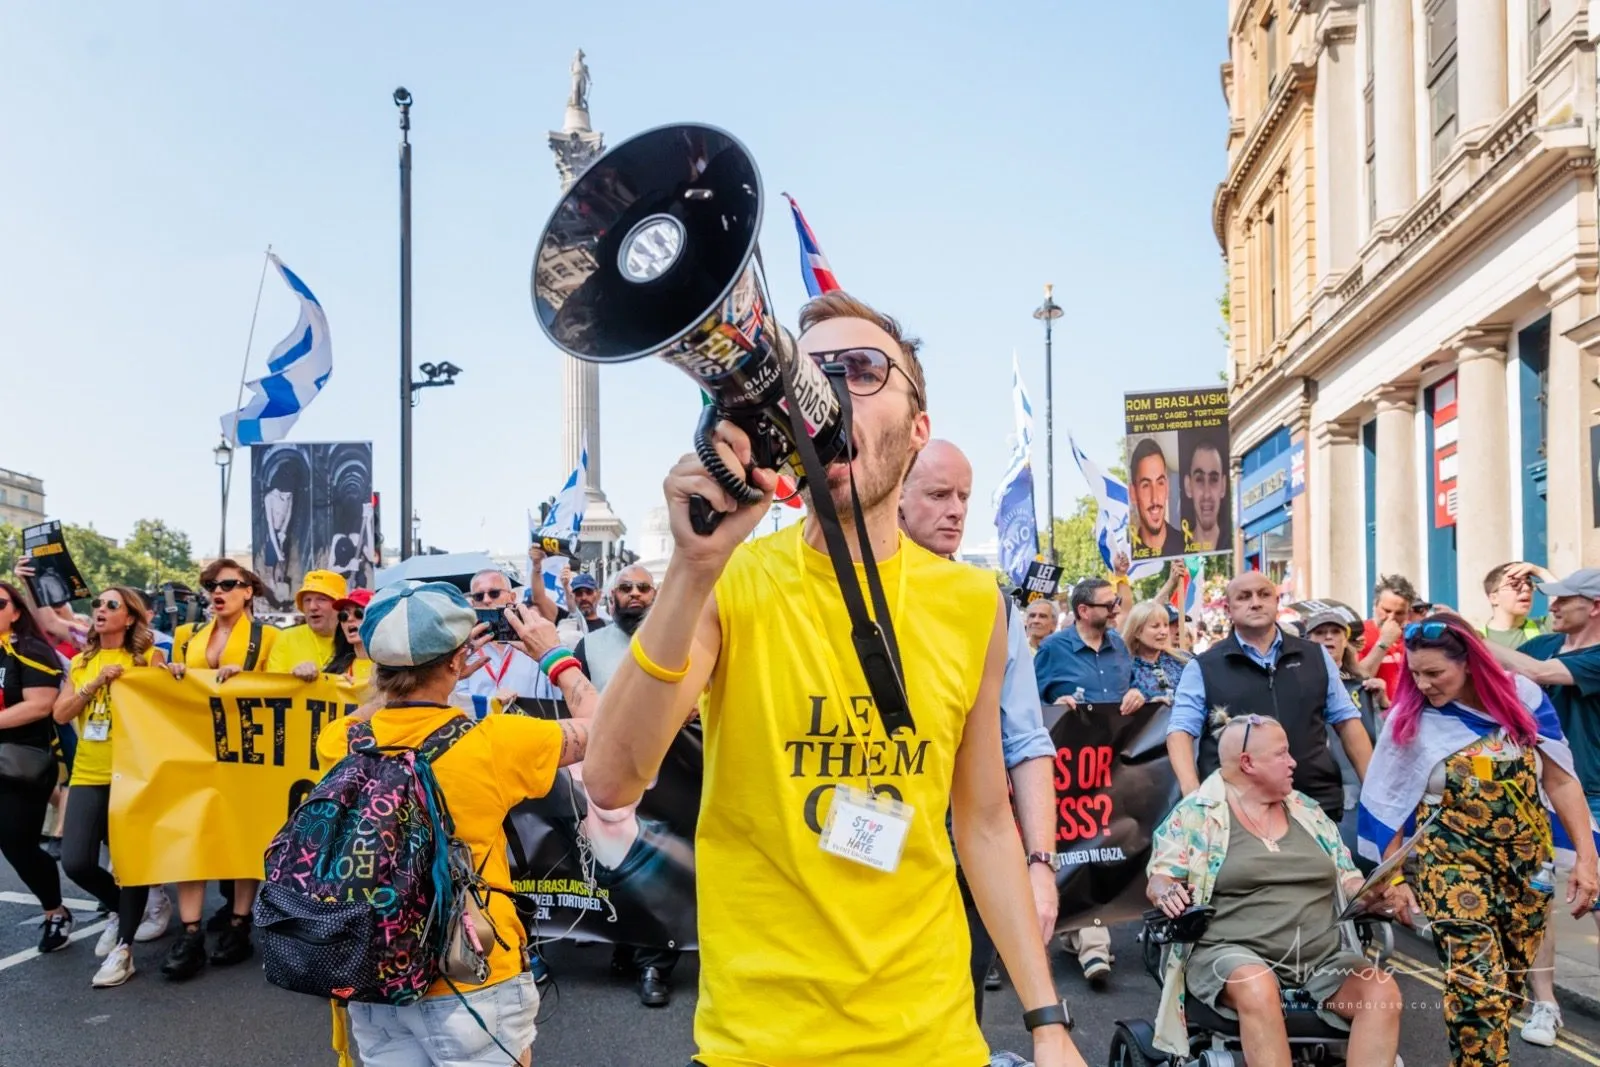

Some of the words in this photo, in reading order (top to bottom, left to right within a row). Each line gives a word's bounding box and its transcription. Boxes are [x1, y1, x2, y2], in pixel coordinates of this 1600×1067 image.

[733, 364, 782, 402] member
[743, 366, 772, 391] 7/10
[794, 373, 828, 426] HMS
[1126, 398, 1151, 411] ROM
[1154, 393, 1229, 409] BRASLAVSKI
[1125, 413, 1158, 422] STARVED
[1164, 410, 1188, 420] CAGED
[1194, 408, 1230, 417] TORTURED
[1147, 422, 1165, 431] YOUR
[1166, 420, 1193, 430] HEROES
[1203, 419, 1222, 427] GAZA
[1036, 564, 1056, 580] LET
[1026, 576, 1056, 593] THEM
[209, 696, 292, 766] LET
[785, 740, 931, 778] THEM
[1078, 746, 1113, 789] OR
[855, 828, 876, 844] THE
[847, 838, 874, 855] HATE
[1058, 850, 1090, 867] TURED
[1090, 848, 1100, 862] IN
[512, 879, 536, 893] ROM
